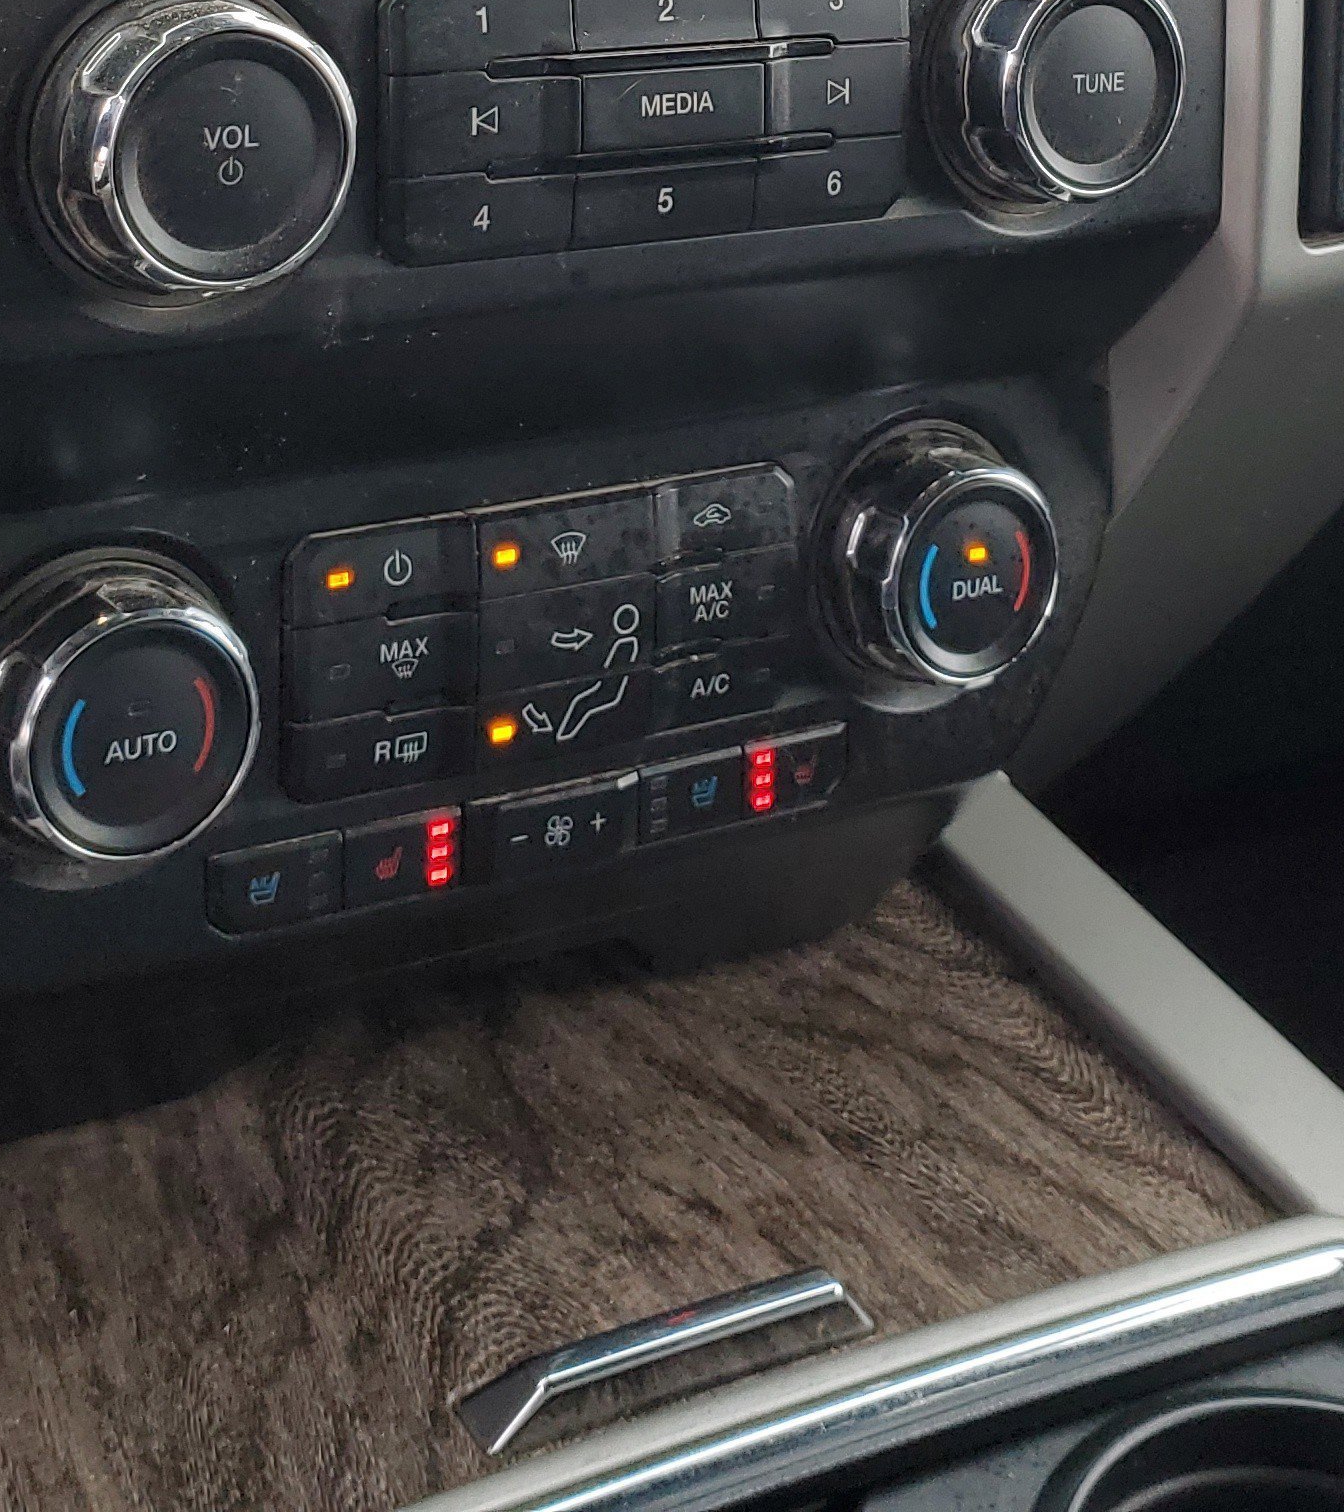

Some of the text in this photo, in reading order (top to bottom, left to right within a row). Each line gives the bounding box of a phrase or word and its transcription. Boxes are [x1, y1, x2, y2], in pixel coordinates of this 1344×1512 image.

[475, 6, 488, 34] 1
[1072, 71, 1125, 95] TUNE
[641, 90, 715, 118] MEDIA
[203, 124, 260, 151] VOL
[827, 170, 843, 196] 6
[657, 187, 674, 214] 5
[473, 204, 491, 232] 4
[690, 580, 733, 606] MAX
[952, 574, 1004, 602] DUAL
[694, 599, 730, 623] A/C
[380, 637, 429, 663] MAX
[691, 673, 731, 699] A/C
[103, 730, 177, 766] AUTO
[374, 740, 391, 764] R
